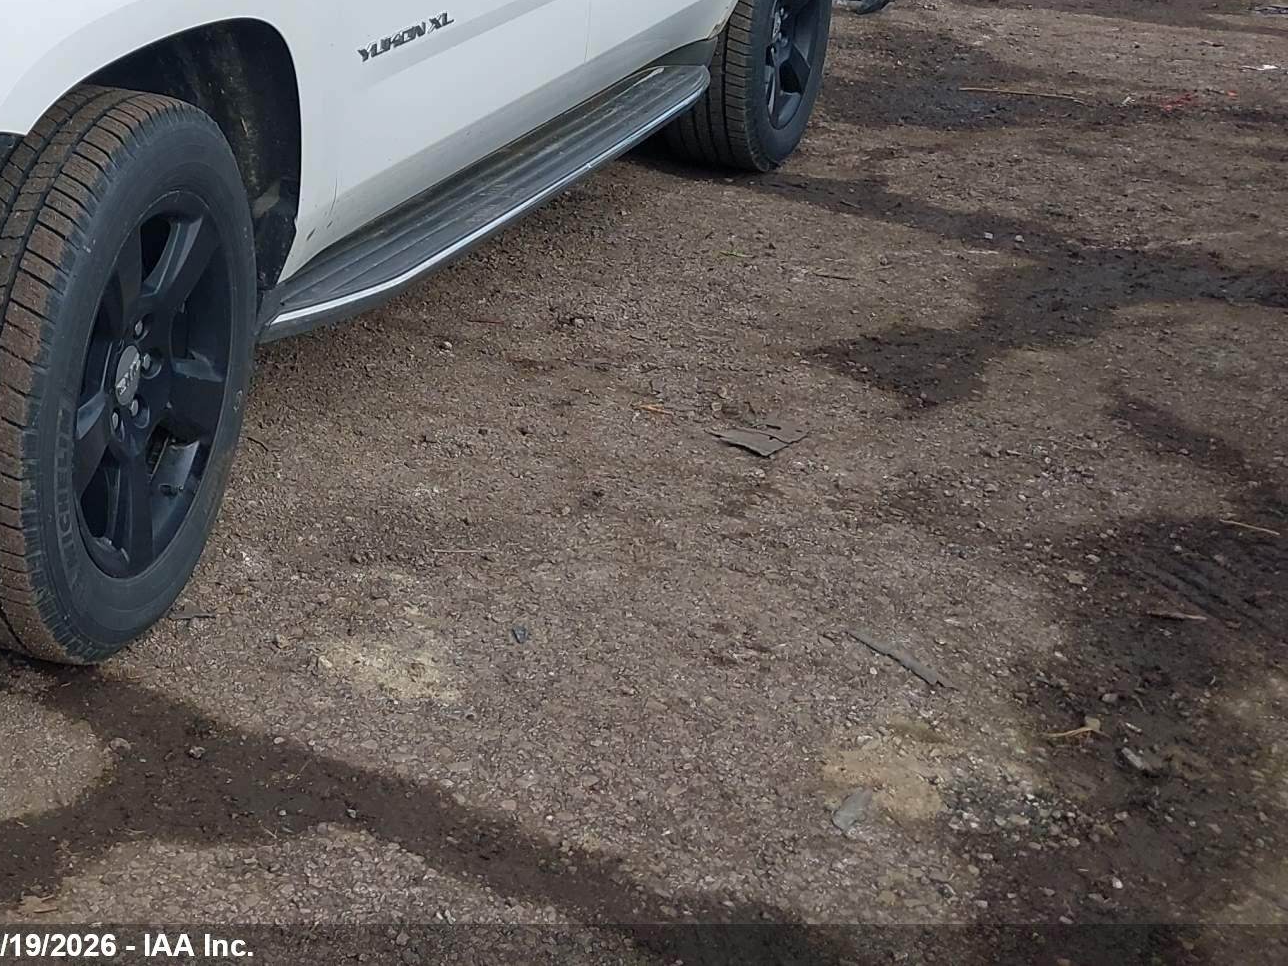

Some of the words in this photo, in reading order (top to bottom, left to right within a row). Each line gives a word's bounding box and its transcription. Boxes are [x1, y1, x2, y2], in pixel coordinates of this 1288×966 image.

[357, 21, 426, 62] YUKON
[427, 11, 455, 34] XL
[53, 406, 79, 587] MICHELIN
